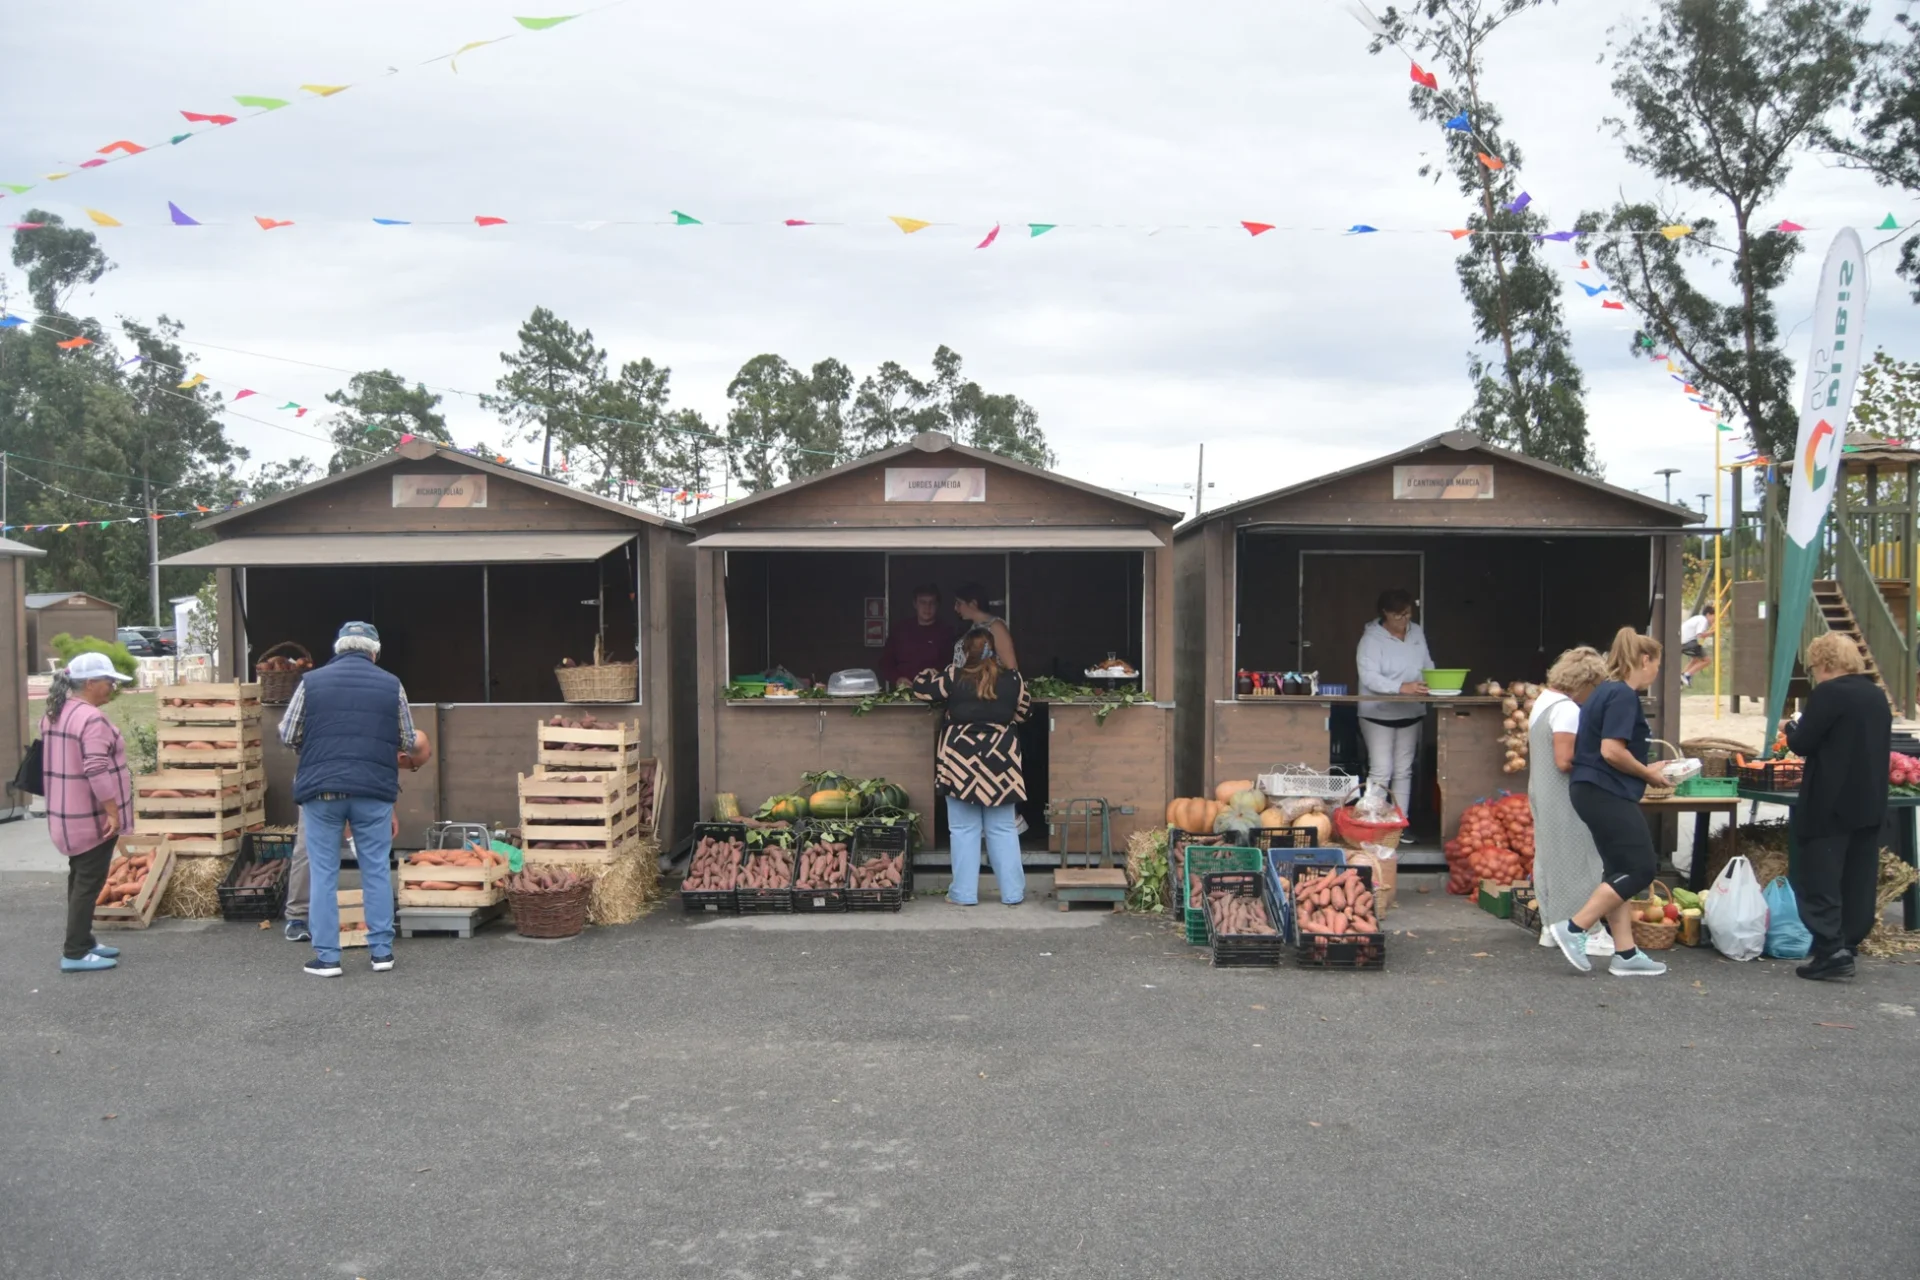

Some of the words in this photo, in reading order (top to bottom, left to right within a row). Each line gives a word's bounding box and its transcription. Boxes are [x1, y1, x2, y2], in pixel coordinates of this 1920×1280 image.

[908, 480, 932, 489] LURDES
[934, 480, 961, 489] ALMEIDA
[1413, 478, 1443, 487] CANTINHO
